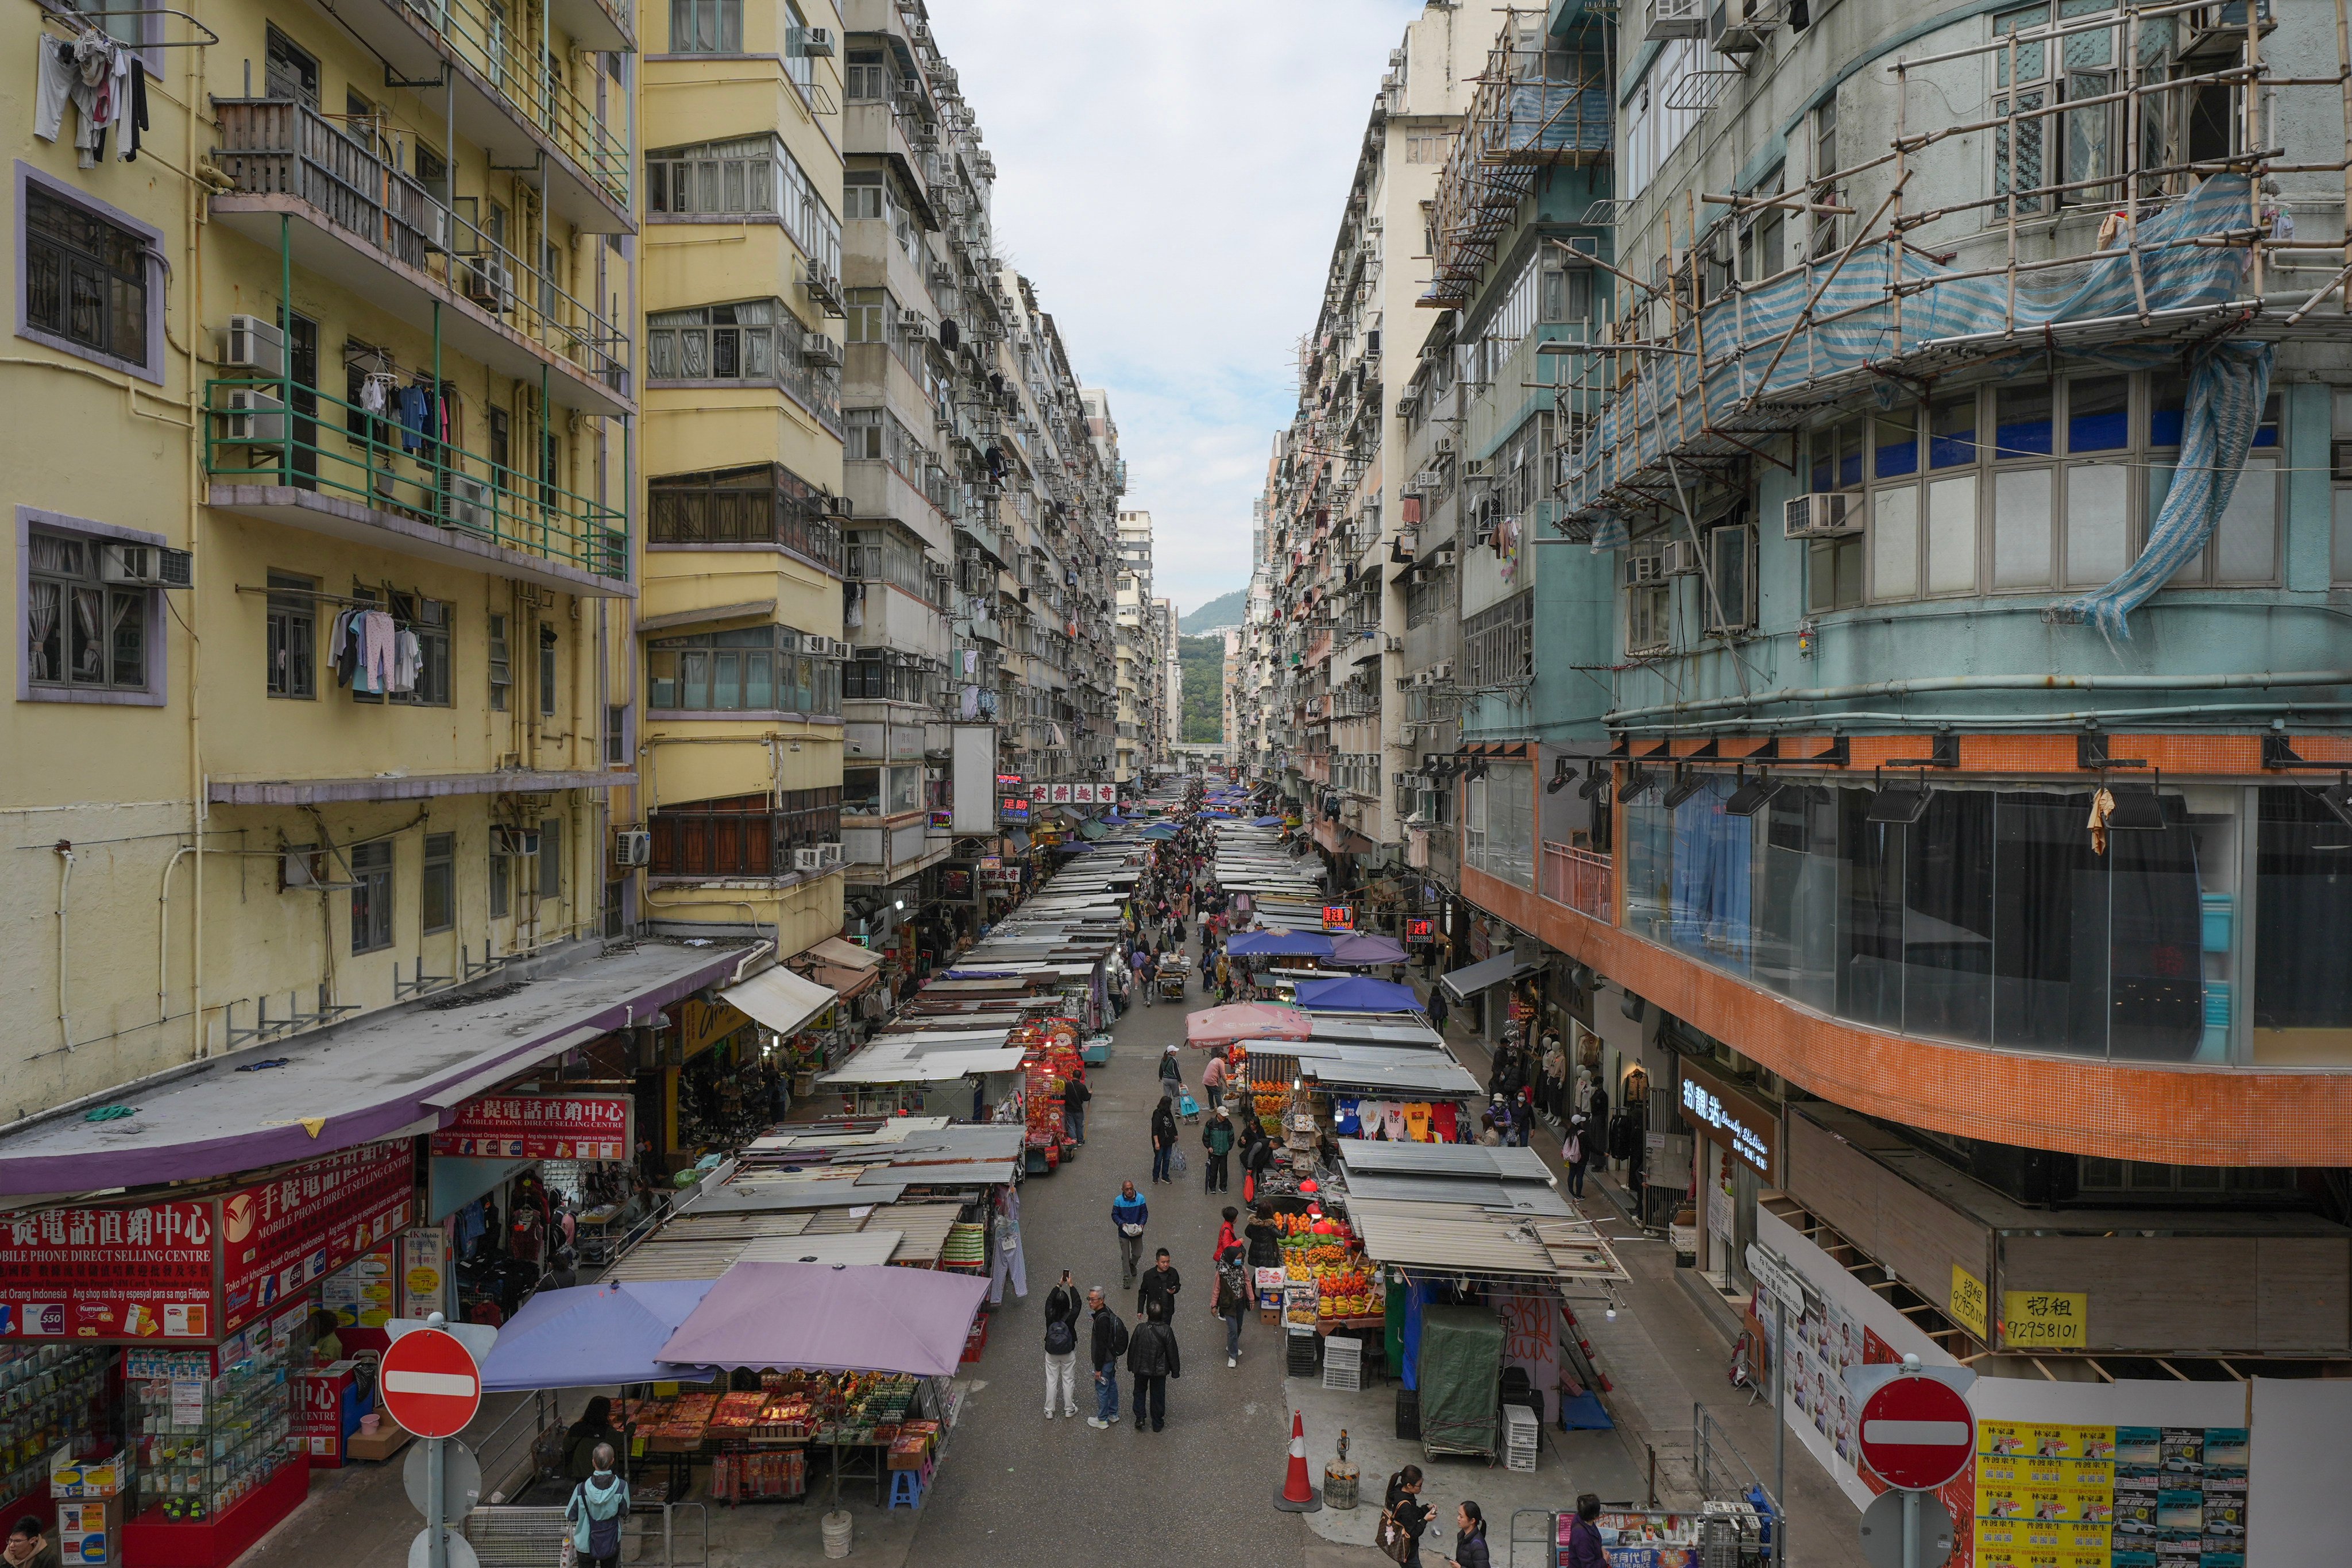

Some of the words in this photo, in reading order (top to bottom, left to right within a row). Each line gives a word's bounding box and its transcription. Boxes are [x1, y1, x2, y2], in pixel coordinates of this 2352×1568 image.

[1003, 799, 1028, 810] 足跡
[1721, 1110, 1743, 1137] Beauty
[1742, 1128, 1767, 1154] Station
[258, 1212, 292, 1241] MOBILE
[294, 1200, 322, 1223] PHONE
[323, 1184, 352, 1206] DIRECT
[352, 1169, 384, 1192] SELLING
[384, 1153, 411, 1177] CENTRE
[0, 1204, 210, 1246] 提電話直銷中心
[225, 1279, 240, 1295] Toko
[249, 1265, 270, 1283] khusus
[271, 1258, 283, 1271] buat
[284, 1247, 300, 1264] Orang
[300, 1234, 326, 1253] Indonesia
[329, 1227, 337, 1237] Ang
[337, 1222, 346, 1234] shop
[362, 1204, 377, 1219] espesyal
[377, 1201, 385, 1210] para
[391, 1193, 399, 1202] mga
[399, 1185, 411, 1199] Filipino
[30, 1250, 68, 1262] PHONE
[71, 1250, 113, 1262] DIRECT
[114, 1250, 163, 1262] SELLING
[165, 1250, 210, 1262] CENTRE
[1759, 1256, 1764, 1266] Fa
[1766, 1260, 1775, 1275] Yuen
[1775, 1270, 1789, 1288] Street
[181, 1280, 192, 1288] and
[1766, 1274, 1782, 1296] 花園街
[9, 1289, 30, 1301] Orang
[33, 1288, 67, 1299] Indonesia
[73, 1289, 85, 1301] Ang
[86, 1289, 100, 1300] shop
[101, 1291, 109, 1299] na
[118, 1291, 125, 1301] ay
[126, 1289, 151, 1301] espesyal
[153, 1291, 164, 1301] para
[175, 1291, 187, 1301] mga
[188, 1289, 210, 1301] Filipino
[1964, 1279, 1982, 1304] 招租
[1953, 1291, 1986, 1330] 92958101
[2027, 1296, 2072, 1317] 招租
[43, 1314, 61, 1323] $50
[78, 1327, 98, 1336] CSL
[2007, 1321, 2077, 1339] 92958101
[319, 1424, 335, 1432] Filipino
[1988, 1427, 2015, 1435] 林家謙
[2034, 1430, 2061, 1438] 林家謙
[1986, 1490, 2013, 1498] 林家謙
[2032, 1493, 2058, 1501] 林家謙
[2077, 1494, 2104, 1503] 林家謙
[1627, 1516, 1645, 1525] $3,000
[1985, 1554, 2012, 1562] 林家謙
[2030, 1556, 2057, 1565] 林家謙
